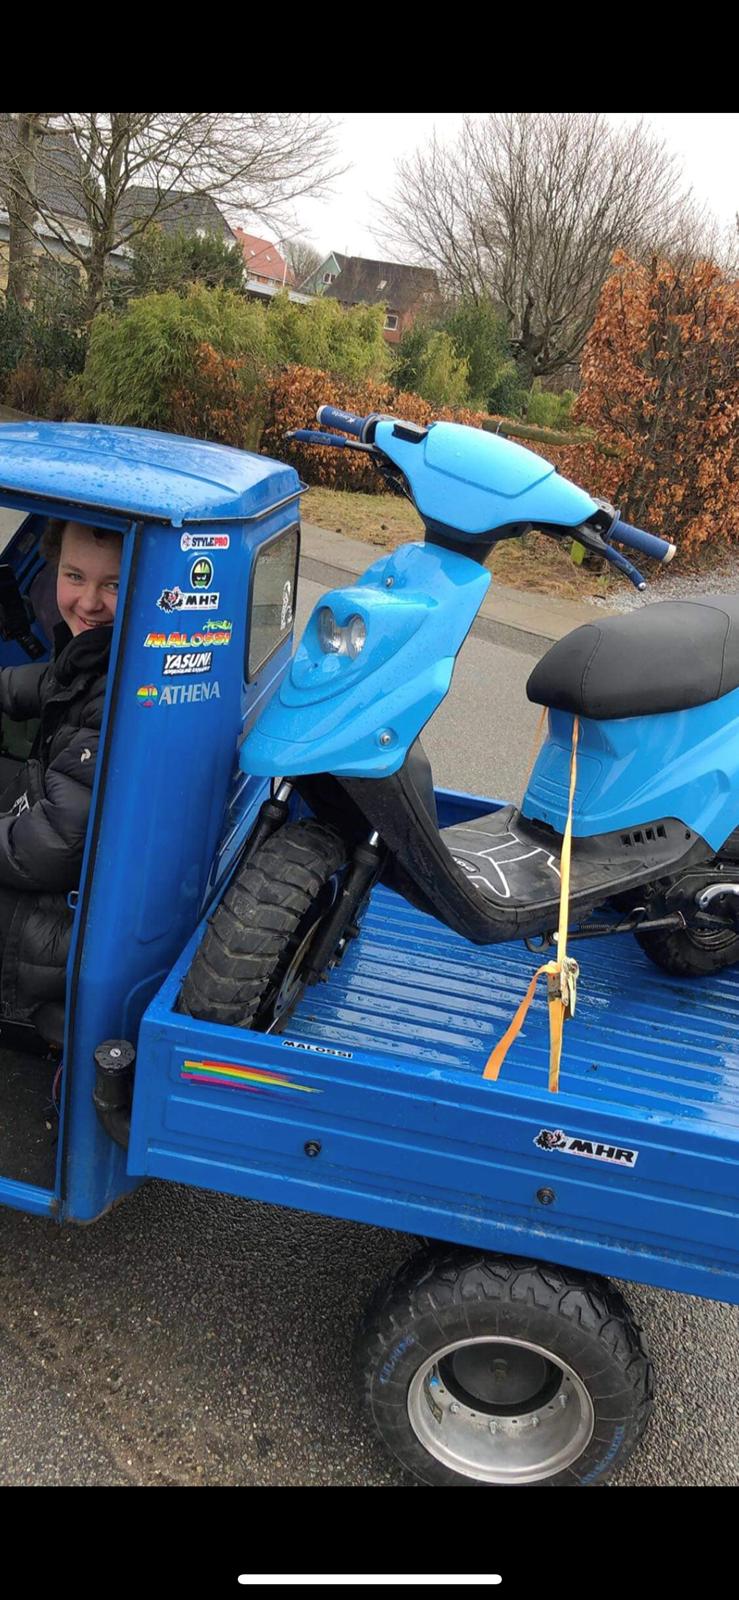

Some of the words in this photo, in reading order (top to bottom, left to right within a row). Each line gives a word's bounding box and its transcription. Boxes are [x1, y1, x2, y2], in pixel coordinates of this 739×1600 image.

[185, 595, 217, 605] MHR
[143, 631, 231, 648] MALOSSI
[164, 652, 211, 669] YASUNI
[158, 681, 221, 705] ATHENA
[283, 1040, 352, 1058] MALOSSI
[569, 1139, 635, 1163] MHR
